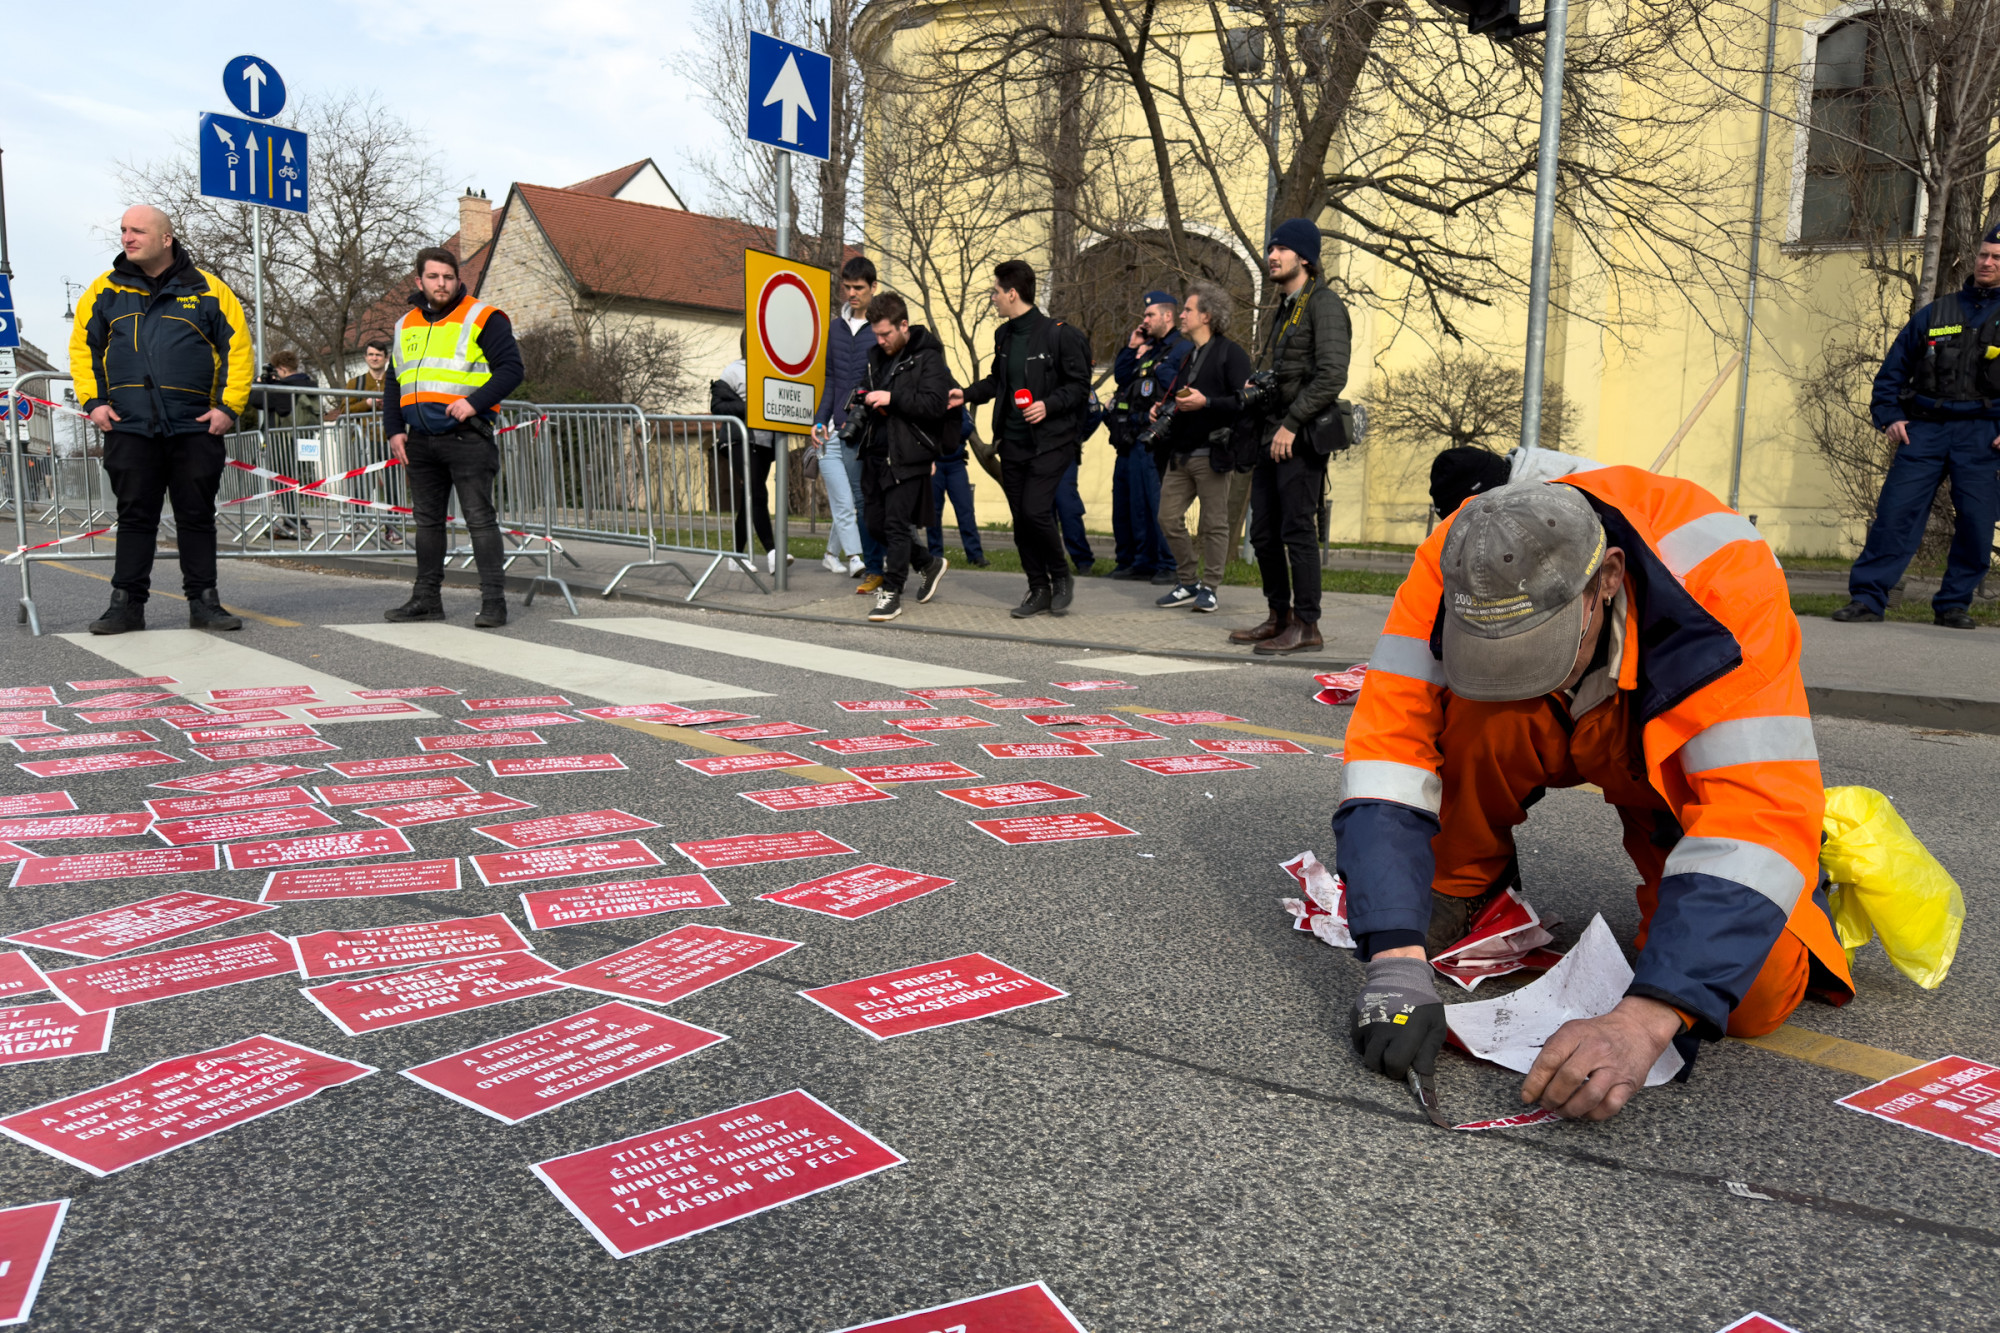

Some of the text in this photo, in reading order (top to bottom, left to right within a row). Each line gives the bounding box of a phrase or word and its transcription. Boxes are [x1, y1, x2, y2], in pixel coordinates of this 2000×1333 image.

[767, 400, 813, 419] CÉLFORGALOM
[779, 386, 801, 402] KIVÉVE
[499, 857, 645, 877] HOGYAN ÉLÜNK!
[501, 849, 573, 860] TITEKET
[522, 851, 608, 864] ÉRDEKEL,
[531, 859, 577, 868] HOGY
[548, 889, 698, 912] A GYERMEKEINK
[582, 882, 646, 893] TITEKET
[604, 886, 679, 898] ÉRDEKEL
[553, 897, 702, 921] BIZTONSÁGA!
[323, 934, 499, 960] A GYERMEKEINK
[337, 929, 475, 947] NEM ÉRDEKEL
[362, 925, 439, 937] TITEKET
[671, 938, 705, 952] HOGY
[329, 941, 502, 968] BIZTONSÁGA!
[597, 938, 683, 970] TITEKET NEM
[617, 939, 727, 983] MINDEN HARMADIK
[629, 940, 750, 989] 17 ÉVES PENÉSZES
[648, 943, 766, 992] LAKÁSBAN NŐ FEL!
[346, 959, 507, 992] TITEKET NEM
[380, 972, 497, 995] ÉRDEKEL,
[398, 977, 500, 1002] HOGY MI
[854, 972, 1003, 1011] ELTAPOSSA AZ
[868, 970, 959, 996] A FIDESZ
[360, 976, 550, 1021] HOGYAN ÉLÜNK
[861, 979, 1031, 1023] EGÉSZSÉGÜGYET!
[476, 1047, 555, 1075] ÉRDEKLI,
[556, 1029, 599, 1046] HOGY
[481, 1031, 557, 1059] FIDESZT
[564, 1017, 599, 1030] NEM
[476, 1023, 654, 1089] GYEREKEINK MINŐSÉGI
[534, 1042, 640, 1083] OKTATÁSBAN
[535, 1043, 675, 1098] RÉSZESÜLJENEK!
[41, 1118, 59, 1126] A
[64, 1089, 143, 1117] FIDESZT
[151, 1072, 191, 1087] NEM
[160, 1082, 304, 1138] A BEVÁSÁRLÁS!
[1875, 1093, 1928, 1114] TITEKET
[1919, 1082, 1952, 1095] NEM
[1932, 1099, 1967, 1113] MI
[55, 1112, 109, 1133] HOGY
[120, 1100, 148, 1112] AZ
[75, 1114, 143, 1140] EGYRE
[149, 1094, 201, 1113] TÖBB
[117, 1111, 187, 1141] JELENT
[1962, 1115, 1994, 1126] A
[610, 1120, 788, 1179] ÉRDEKEL, HOGY
[611, 1114, 763, 1162] TITEKET NEM
[610, 1128, 816, 1196] MINDEN HARMADIK
[612, 1135, 842, 1213] 17 ÉVES PENÉSZES
[628, 1147, 857, 1227] LAKÁSBAN NŐ FEL!
